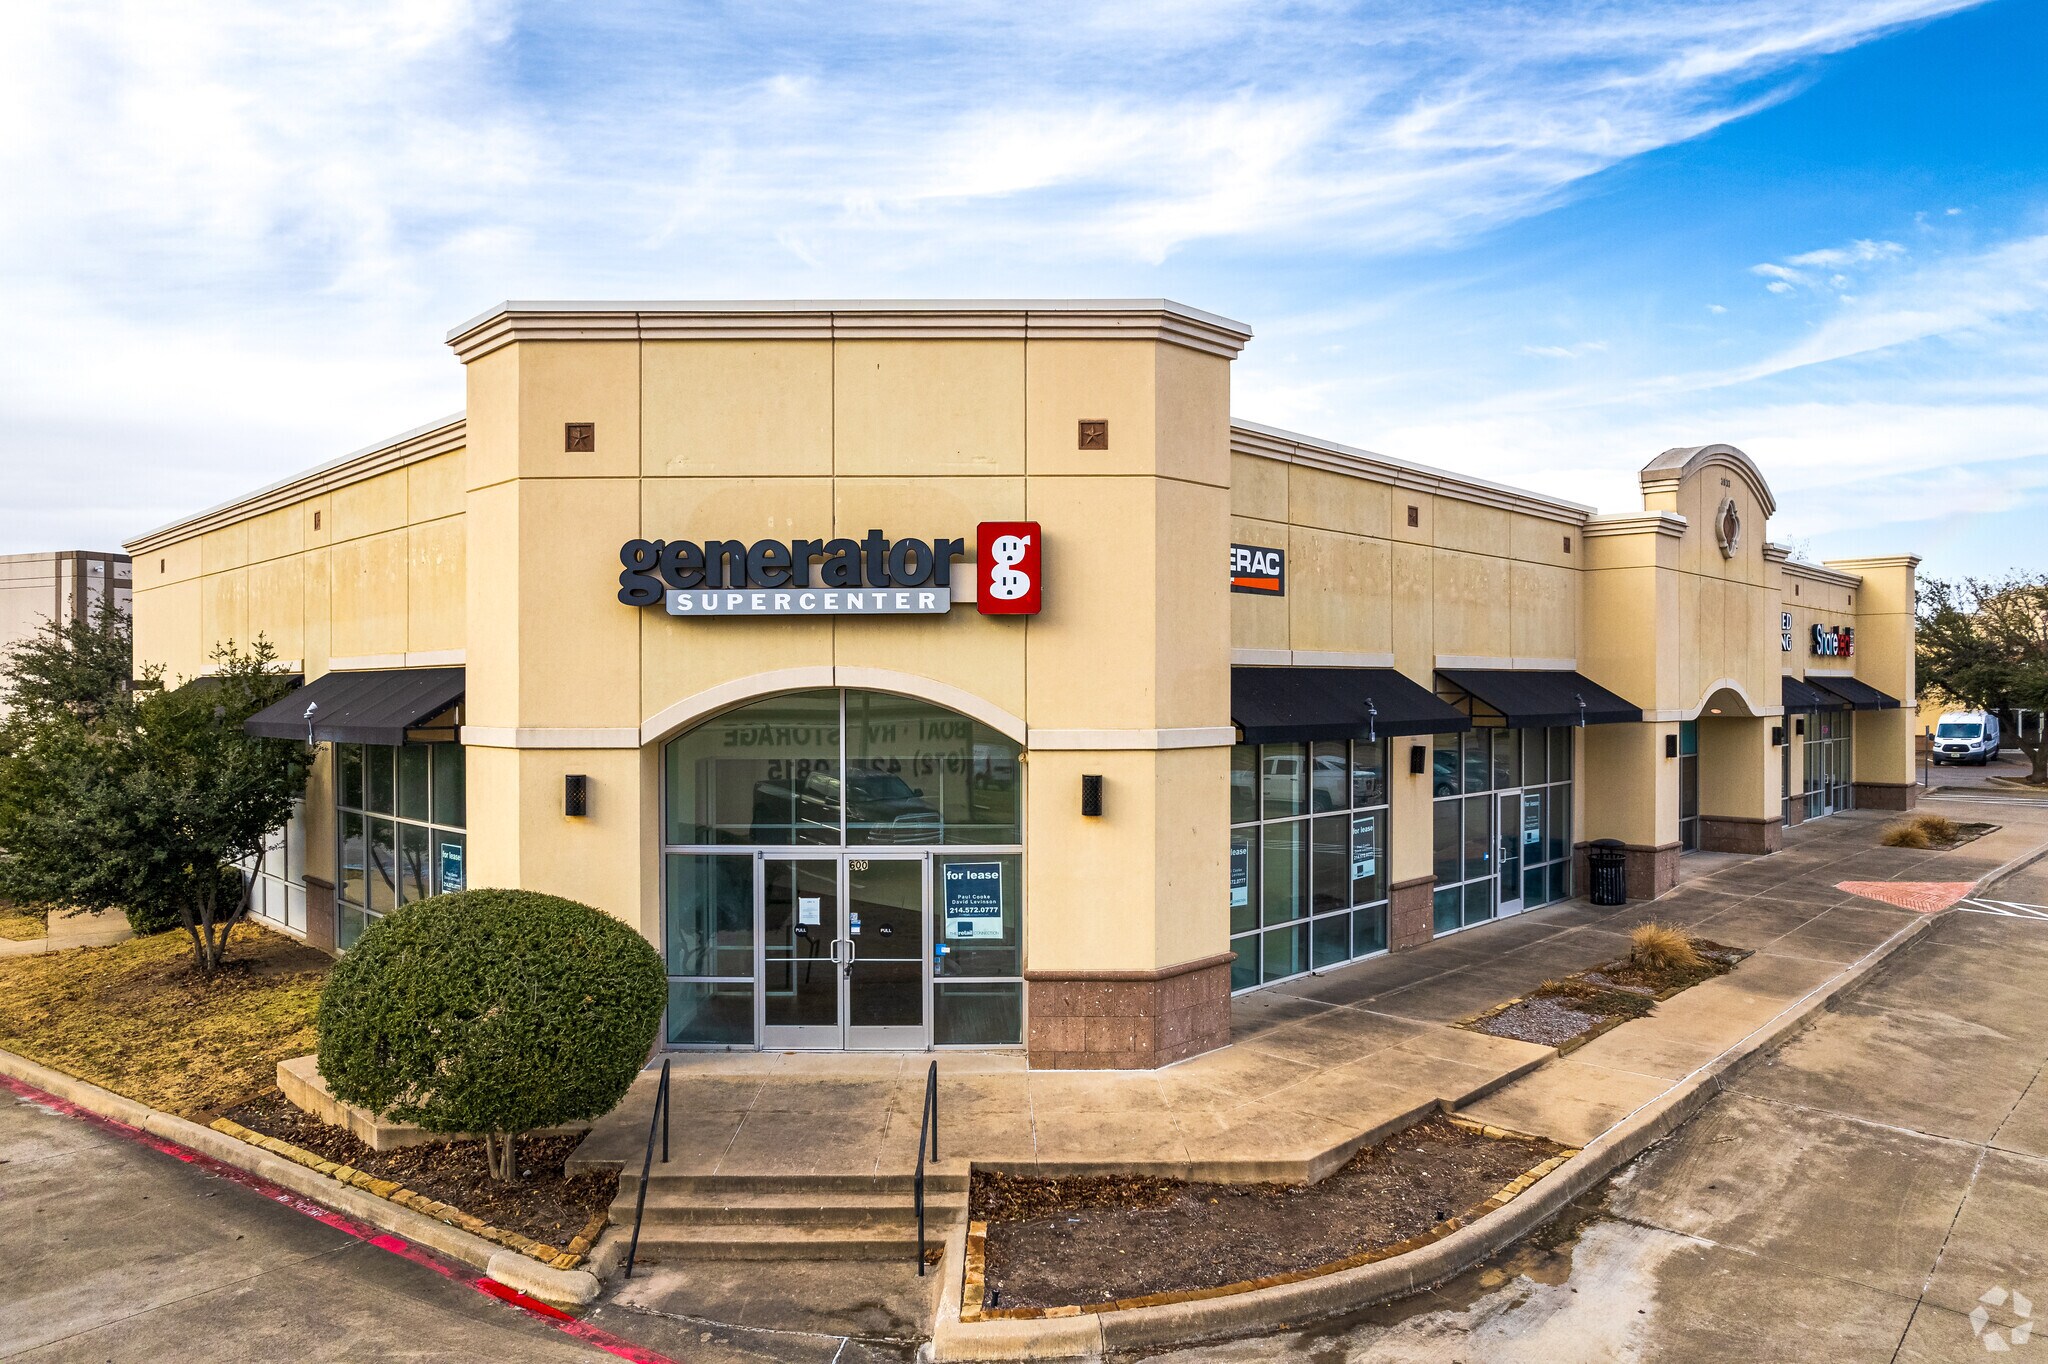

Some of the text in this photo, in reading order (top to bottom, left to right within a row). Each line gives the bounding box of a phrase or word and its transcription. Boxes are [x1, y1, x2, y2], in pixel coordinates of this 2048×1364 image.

[618, 529, 965, 606] generator
[677, 592, 936, 611] SUPERCENTER
[849, 860, 868, 870] 600
[947, 870, 999, 880] for lease
[949, 906, 999, 914] 214.572.0777
